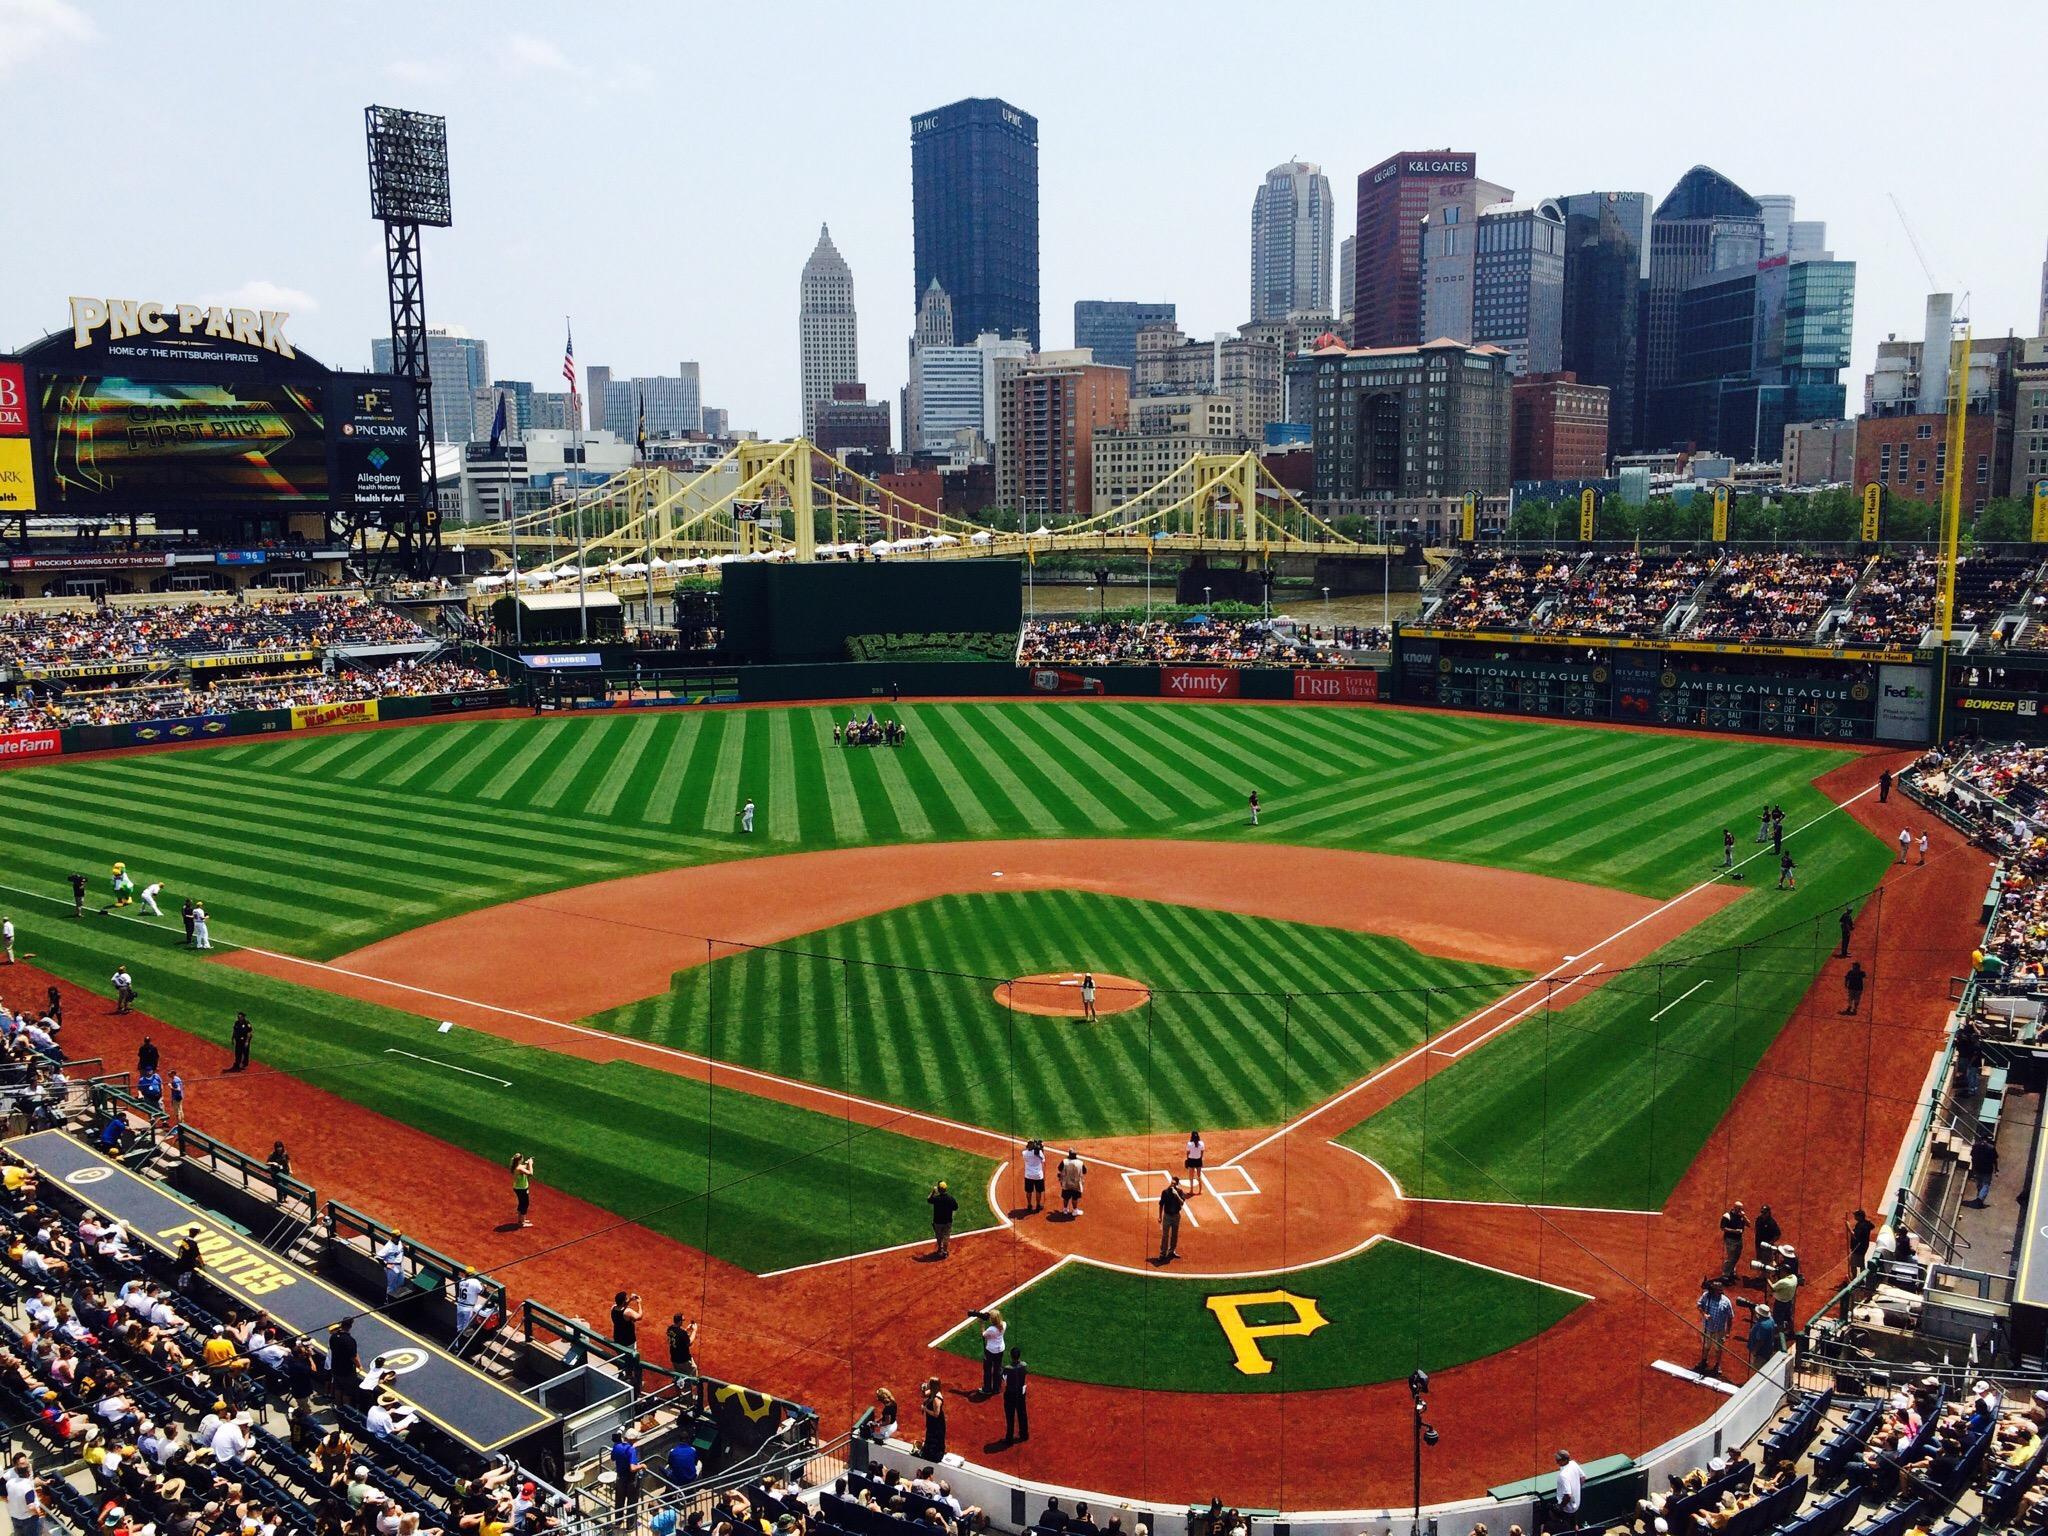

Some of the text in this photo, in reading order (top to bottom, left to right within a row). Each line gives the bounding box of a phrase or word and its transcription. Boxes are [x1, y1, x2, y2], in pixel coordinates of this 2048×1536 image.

[1002, 108, 1023, 128] UPMC
[911, 116, 939, 135] UPMC
[1409, 161, 1468, 172] K&L GATES
[69, 296, 296, 360] PNC PARK
[108, 346, 259, 363] HOME OF THE PITTSBURGH PIRATES
[127, 419, 267, 450] FIRST PITCH
[355, 425, 408, 436] PNC BANK
[357, 473, 401, 484] Allegheny
[355, 494, 405, 502] Health for All
[1584, 493, 1592, 517] Health
[427, 511, 437, 526] P
[1866, 488, 1876, 540] All for Health
[227, 655, 260, 666] LIGHT
[263, 653, 286, 662] BEER
[550, 656, 587, 664] LUMBER
[1874, 652, 1883, 660] for
[1884, 653, 1908, 661] Health
[48, 664, 150, 678] IRON CITY BEER
[1454, 666, 1590, 682] NATIONAL LEAGUE
[1616, 669, 1656, 678] RIVERS
[1171, 673, 1229, 693] xfinity
[1295, 675, 1340, 696] TRIB
[1344, 676, 1375, 687] TOTAL
[1344, 687, 1376, 697] MEDIA
[1680, 682, 1848, 700] AMERICAN LEAGUE
[1884, 685, 1924, 699] FedEx
[1784, 706, 1796, 714] DET
[1964, 699, 2016, 711] BOWSER
[1676, 716, 1688, 724] NYY
[1840, 720, 1853, 728] SEA
[1784, 724, 1794, 732] TEX
[1840, 729, 1853, 737] OAK
[20, 738, 54, 752] Farm
[156, 1221, 297, 1295] PIRATES
[459, 1288, 468, 1300] 16
[1206, 1290, 1330, 1375] P
